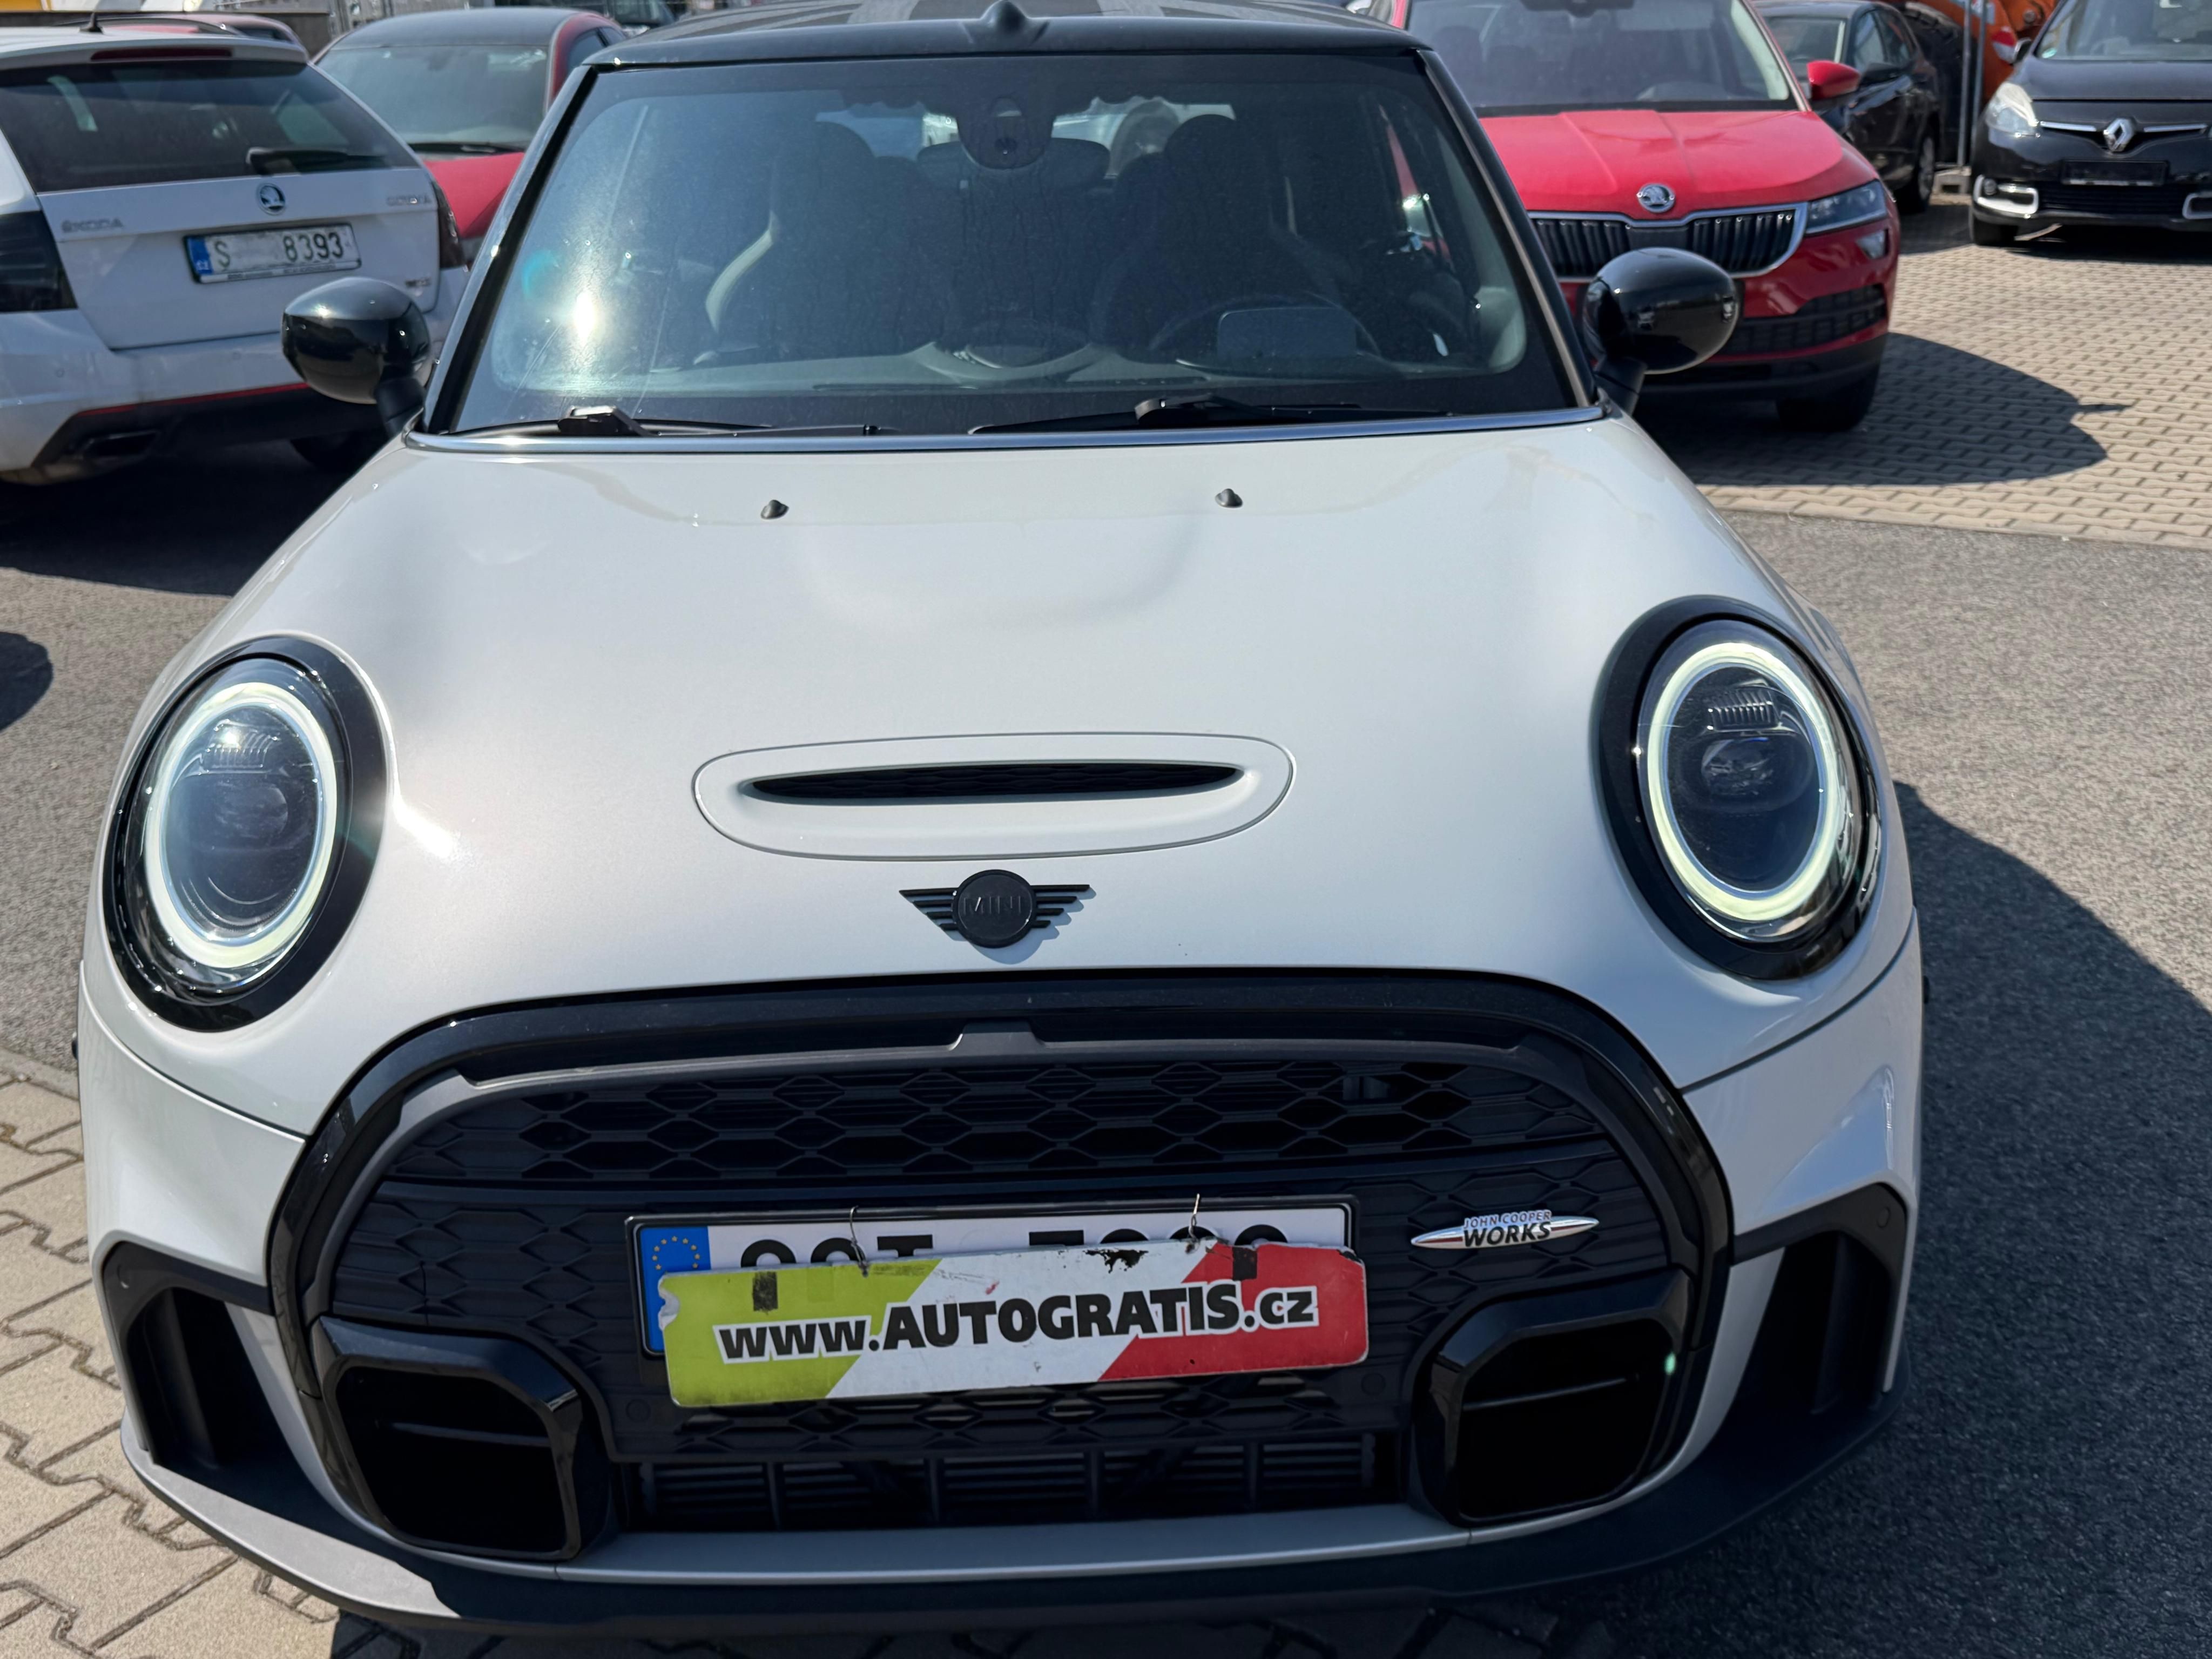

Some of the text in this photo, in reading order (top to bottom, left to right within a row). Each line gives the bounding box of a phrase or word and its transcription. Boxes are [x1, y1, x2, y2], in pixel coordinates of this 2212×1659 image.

[282, 232, 343, 262] 8393
[1464, 1211, 1551, 1229] JOHN COOPER
[1464, 1222, 1551, 1247] WORKS
[719, 1284, 1314, 1359] www.AUTOGRATIS.cz
